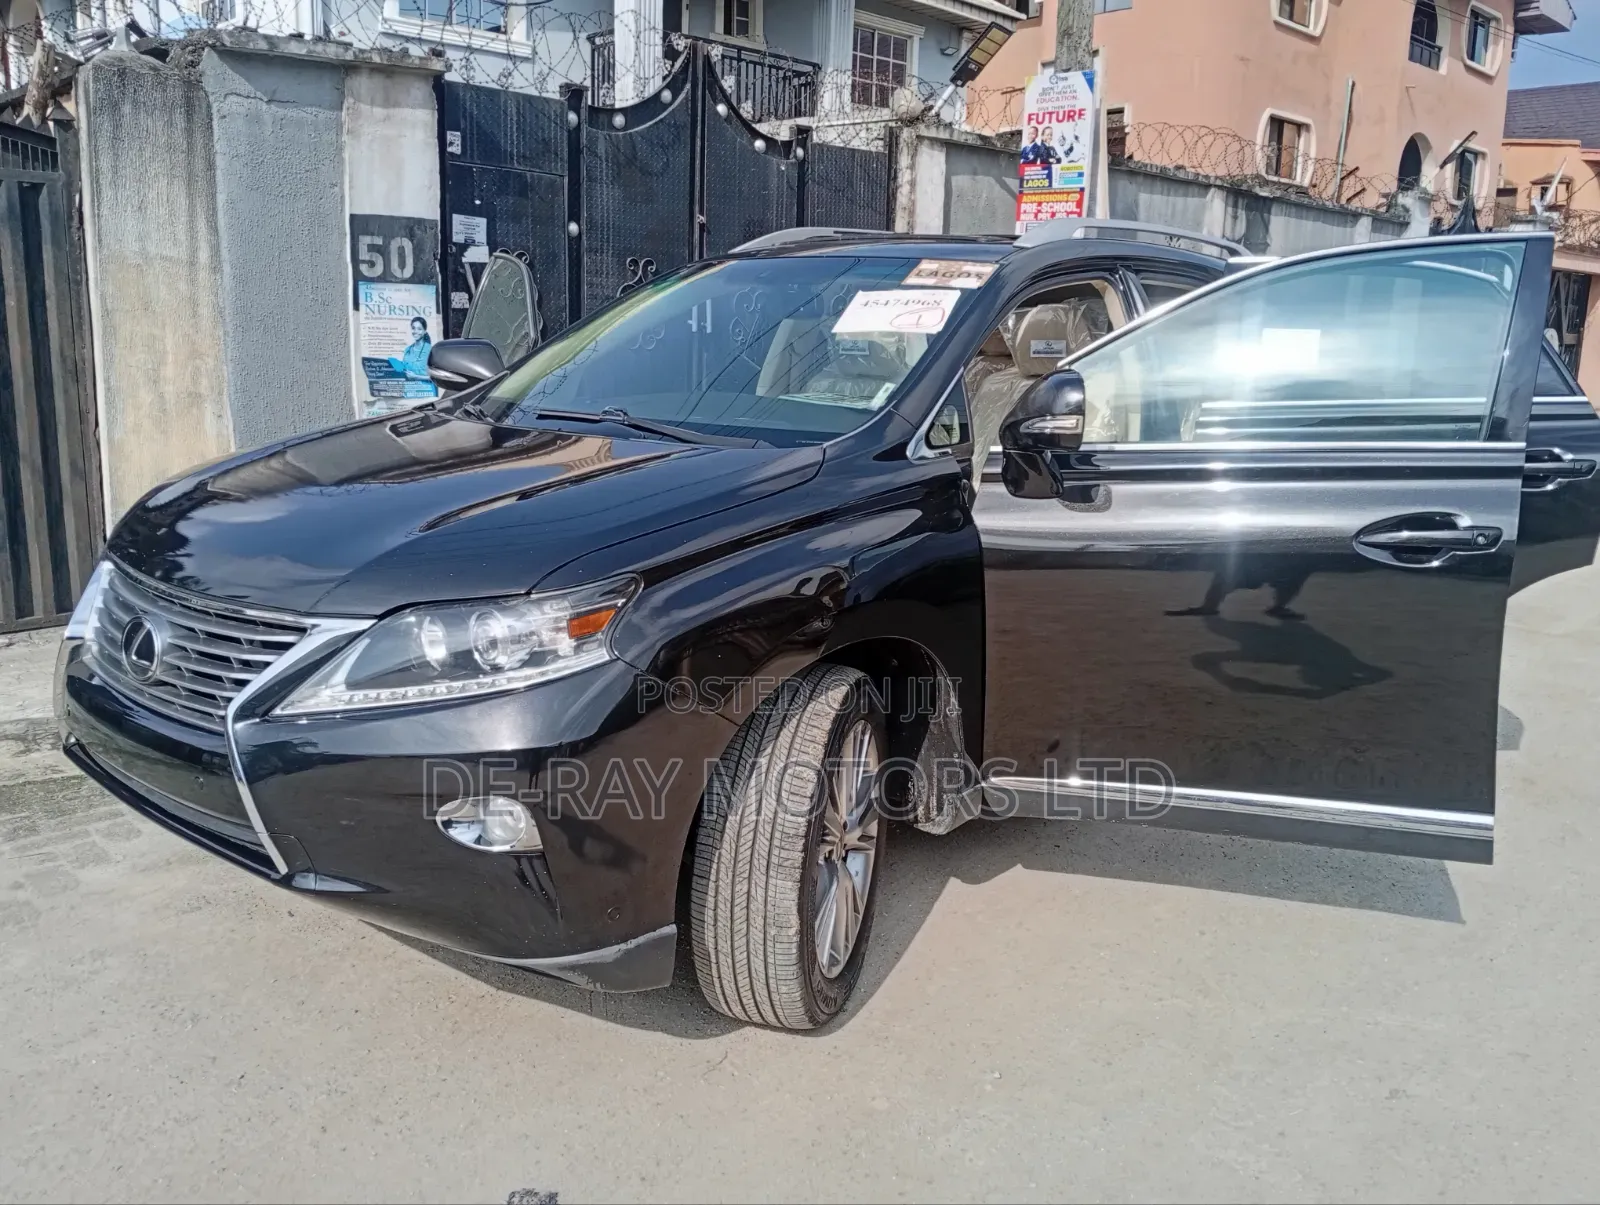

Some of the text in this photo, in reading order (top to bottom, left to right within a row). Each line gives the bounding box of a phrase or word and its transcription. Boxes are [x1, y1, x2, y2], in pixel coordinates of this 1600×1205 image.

[1027, 108, 1086, 125] FUTURE
[1023, 179, 1049, 187] LAGOS
[1021, 194, 1068, 202] ADMISSIONS
[1020, 201, 1080, 213] PRE-SCHOOL,
[358, 235, 414, 279] 50
[914, 269, 985, 280] LAGOS
[364, 291, 392, 304] B.Sc
[364, 304, 433, 318] NURSING
